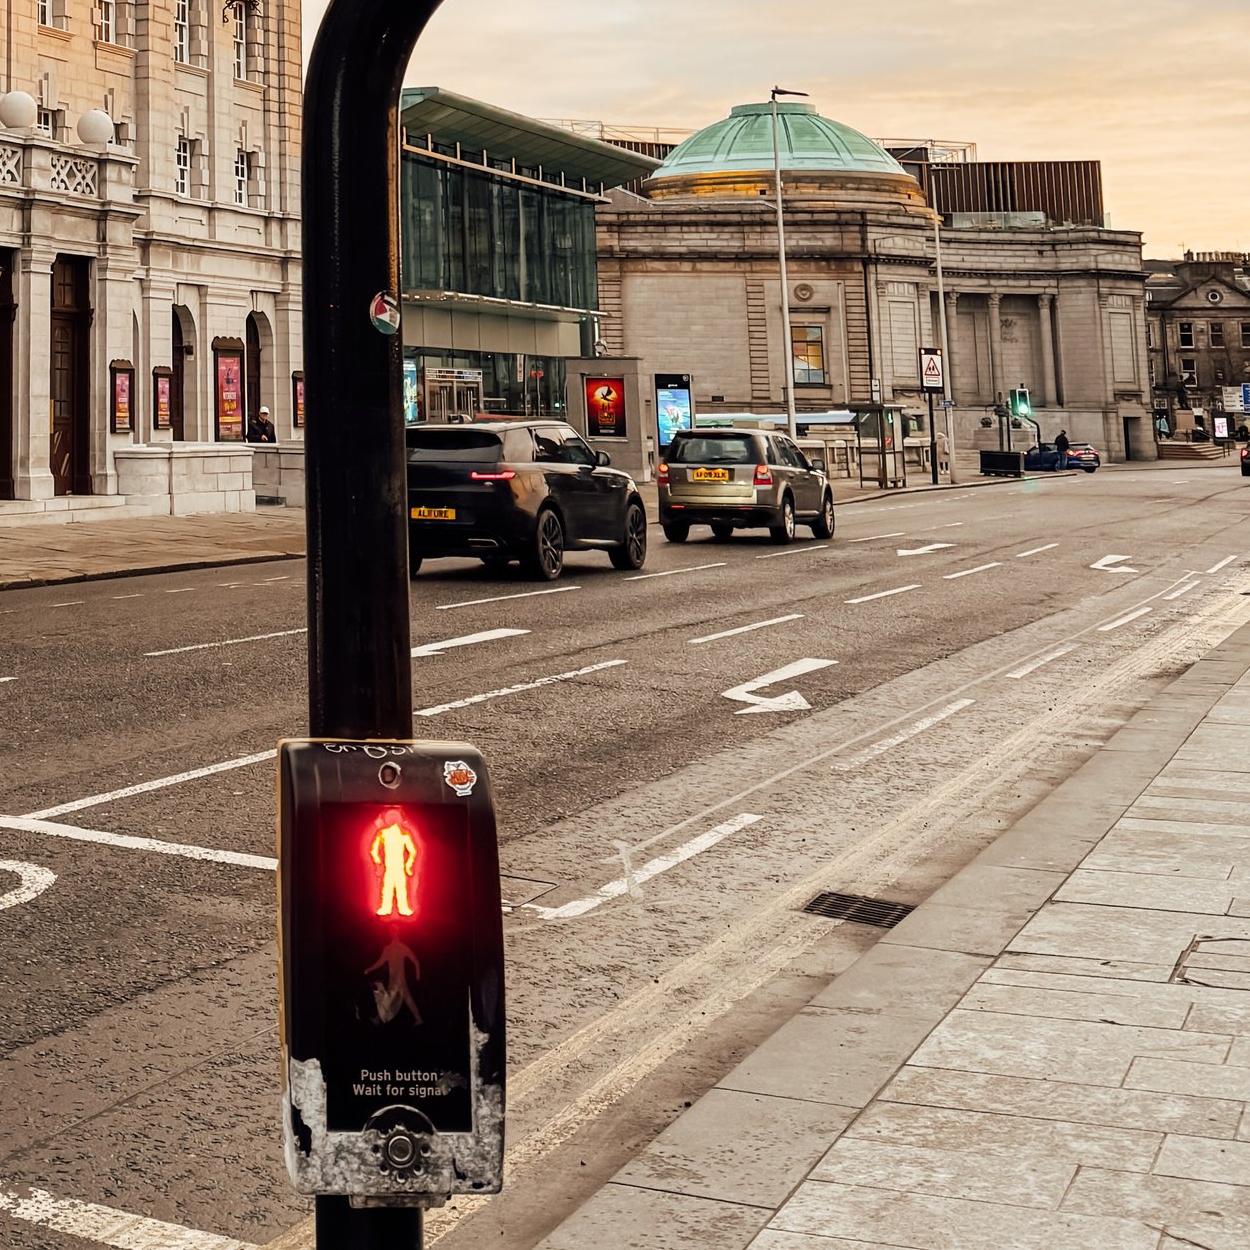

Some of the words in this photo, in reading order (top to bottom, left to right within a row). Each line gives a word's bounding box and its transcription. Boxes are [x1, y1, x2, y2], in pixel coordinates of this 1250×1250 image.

[360, 1069, 391, 1081] Push
[395, 1069, 438, 1081] button
[352, 1083, 382, 1096] Wait
[386, 1083, 405, 1096] for
